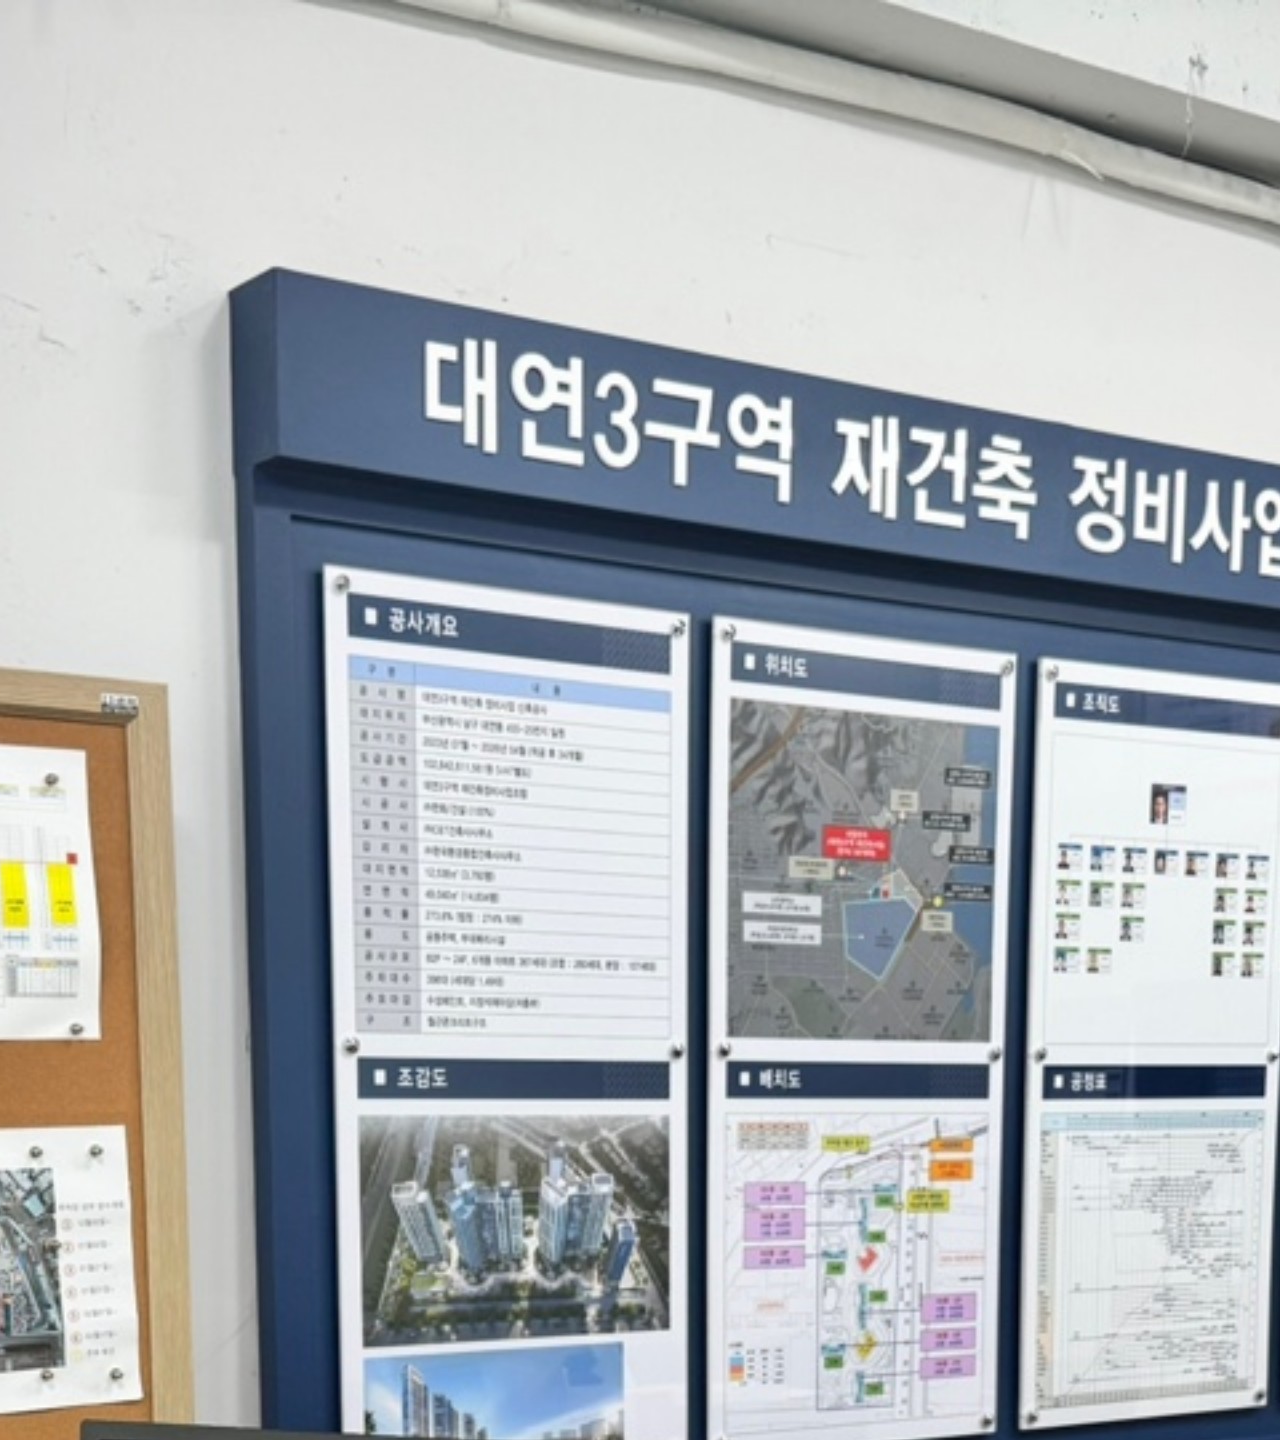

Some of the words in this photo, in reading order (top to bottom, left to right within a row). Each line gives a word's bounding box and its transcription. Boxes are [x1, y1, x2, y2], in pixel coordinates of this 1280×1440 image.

[424, 338, 793, 505] 대연3구역
[830, 415, 1039, 541] 재건축
[388, 606, 459, 638] 공사개요
[764, 652, 809, 678] 위치도
[1082, 692, 1120, 715] 조직도
[396, 1065, 449, 1089] 조감도
[759, 1067, 802, 1090] 배치도
[1070, 1070, 1108, 1092] 공정표
